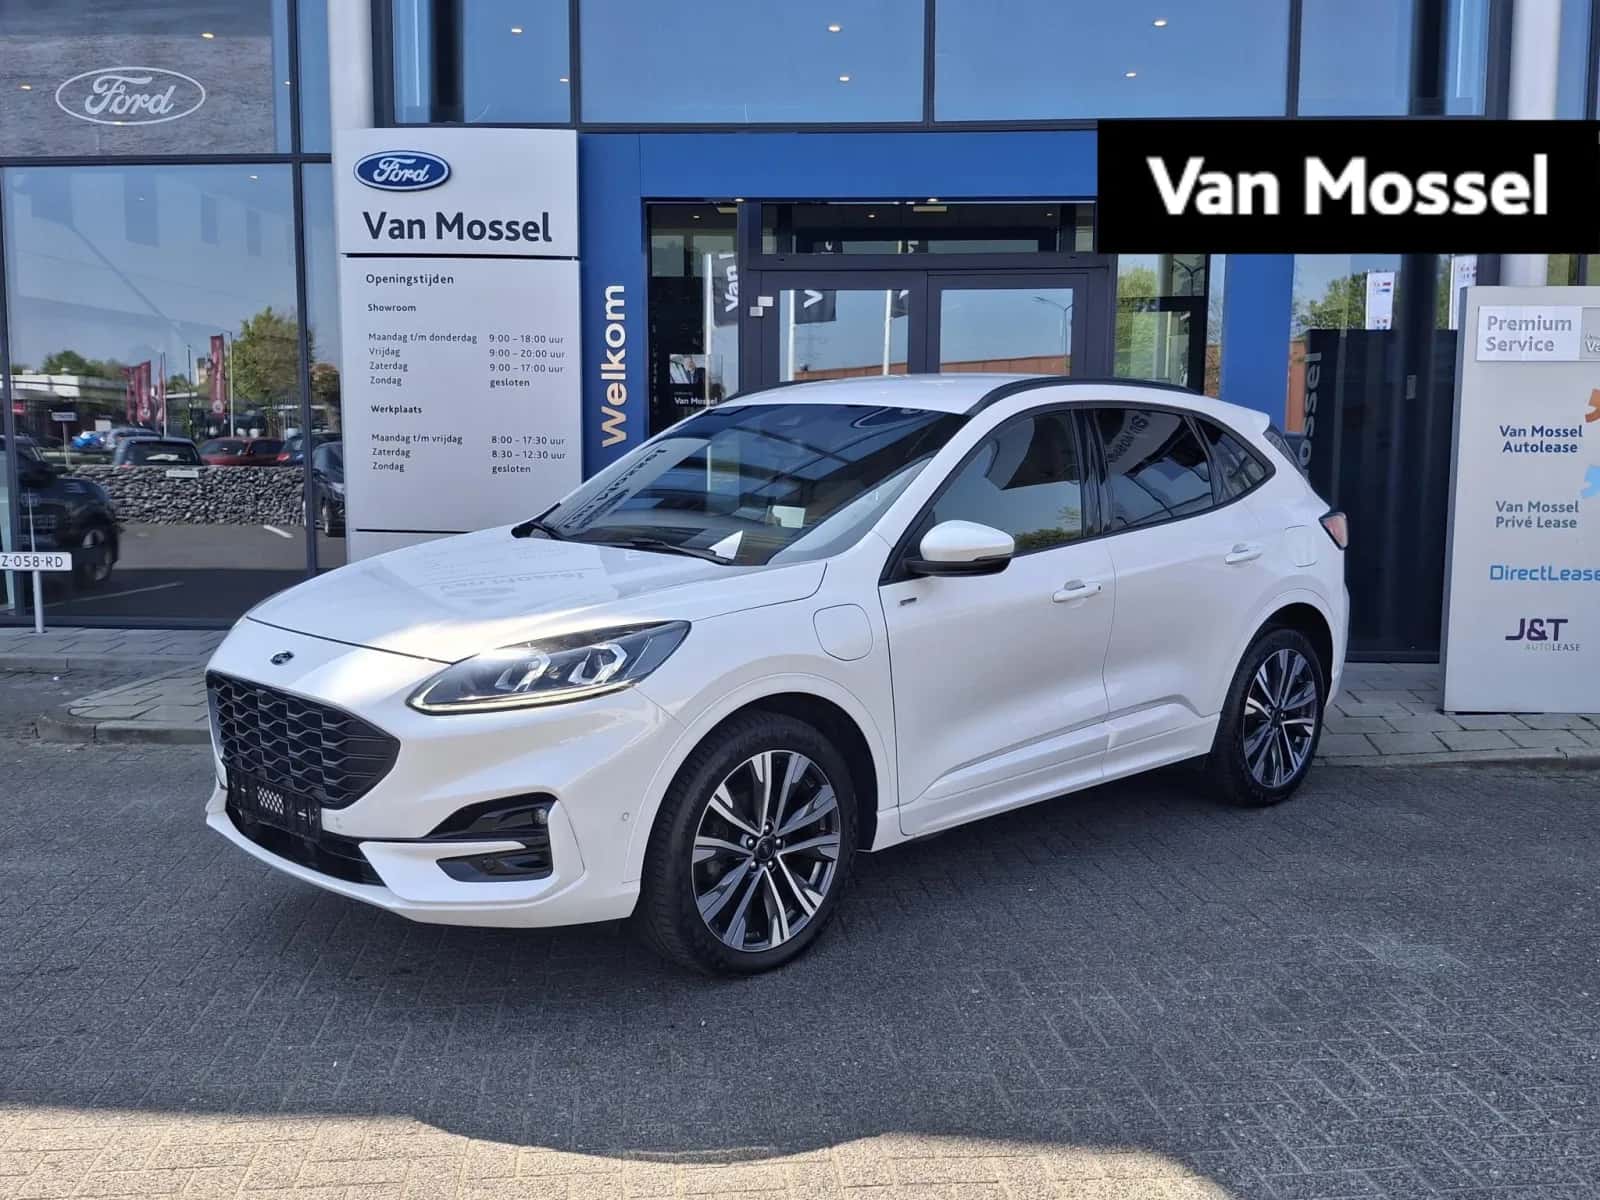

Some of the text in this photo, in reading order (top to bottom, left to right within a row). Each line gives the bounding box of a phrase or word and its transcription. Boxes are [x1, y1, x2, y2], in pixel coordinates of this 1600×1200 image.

[84, 75, 176, 116] Ford
[373, 157, 430, 182] Ford
[363, 211, 552, 242] Van Mossel
[366, 273, 454, 287] Openingstijden
[367, 303, 416, 312] Showroom
[1487, 315, 1572, 331] Premium
[368, 332, 408, 344] Maandag
[410, 332, 427, 342] t/m
[429, 332, 477, 345] donderdag
[489, 334, 510, 343] 9:00
[520, 334, 546, 344] 18:00
[549, 336, 564, 344] uur
[1486, 336, 1554, 352] Service
[369, 346, 401, 358] Vrijdag
[489, 348, 510, 358] 9:00
[520, 349, 547, 358] 20:00
[550, 351, 565, 359] uur
[369, 360, 408, 373] Zaterdag
[489, 363, 511, 372] 9:00
[521, 364, 546, 373] 17:00
[600, 285, 627, 448] Welkom
[370, 375, 530, 389] Zondag gesloten
[371, 404, 423, 416] Werkplaats
[1499, 425, 1583, 438] Van Mossel
[371, 433, 411, 445] Maandag
[413, 433, 430, 443] t/m
[432, 434, 463, 446] vrijdag
[491, 435, 513, 444] 8:00
[523, 436, 548, 445] 17:30
[1502, 440, 1578, 453] Autolease
[372, 447, 411, 459] Zaterdag
[492, 449, 513, 458] 8:30
[523, 450, 549, 459] 12:30
[551, 452, 567, 460] uur
[372, 461, 531, 475] Zondag gesloten
[1495, 500, 1579, 513] Van Mossel
[1495, 515, 1577, 529] Privé Lease
[1, 555, 63, 568] Z-058-RD
[1489, 564, 1600, 582] DirectLease
[1505, 618, 1568, 642] J&T
[1524, 643, 1580, 652] AUTOLEASE
